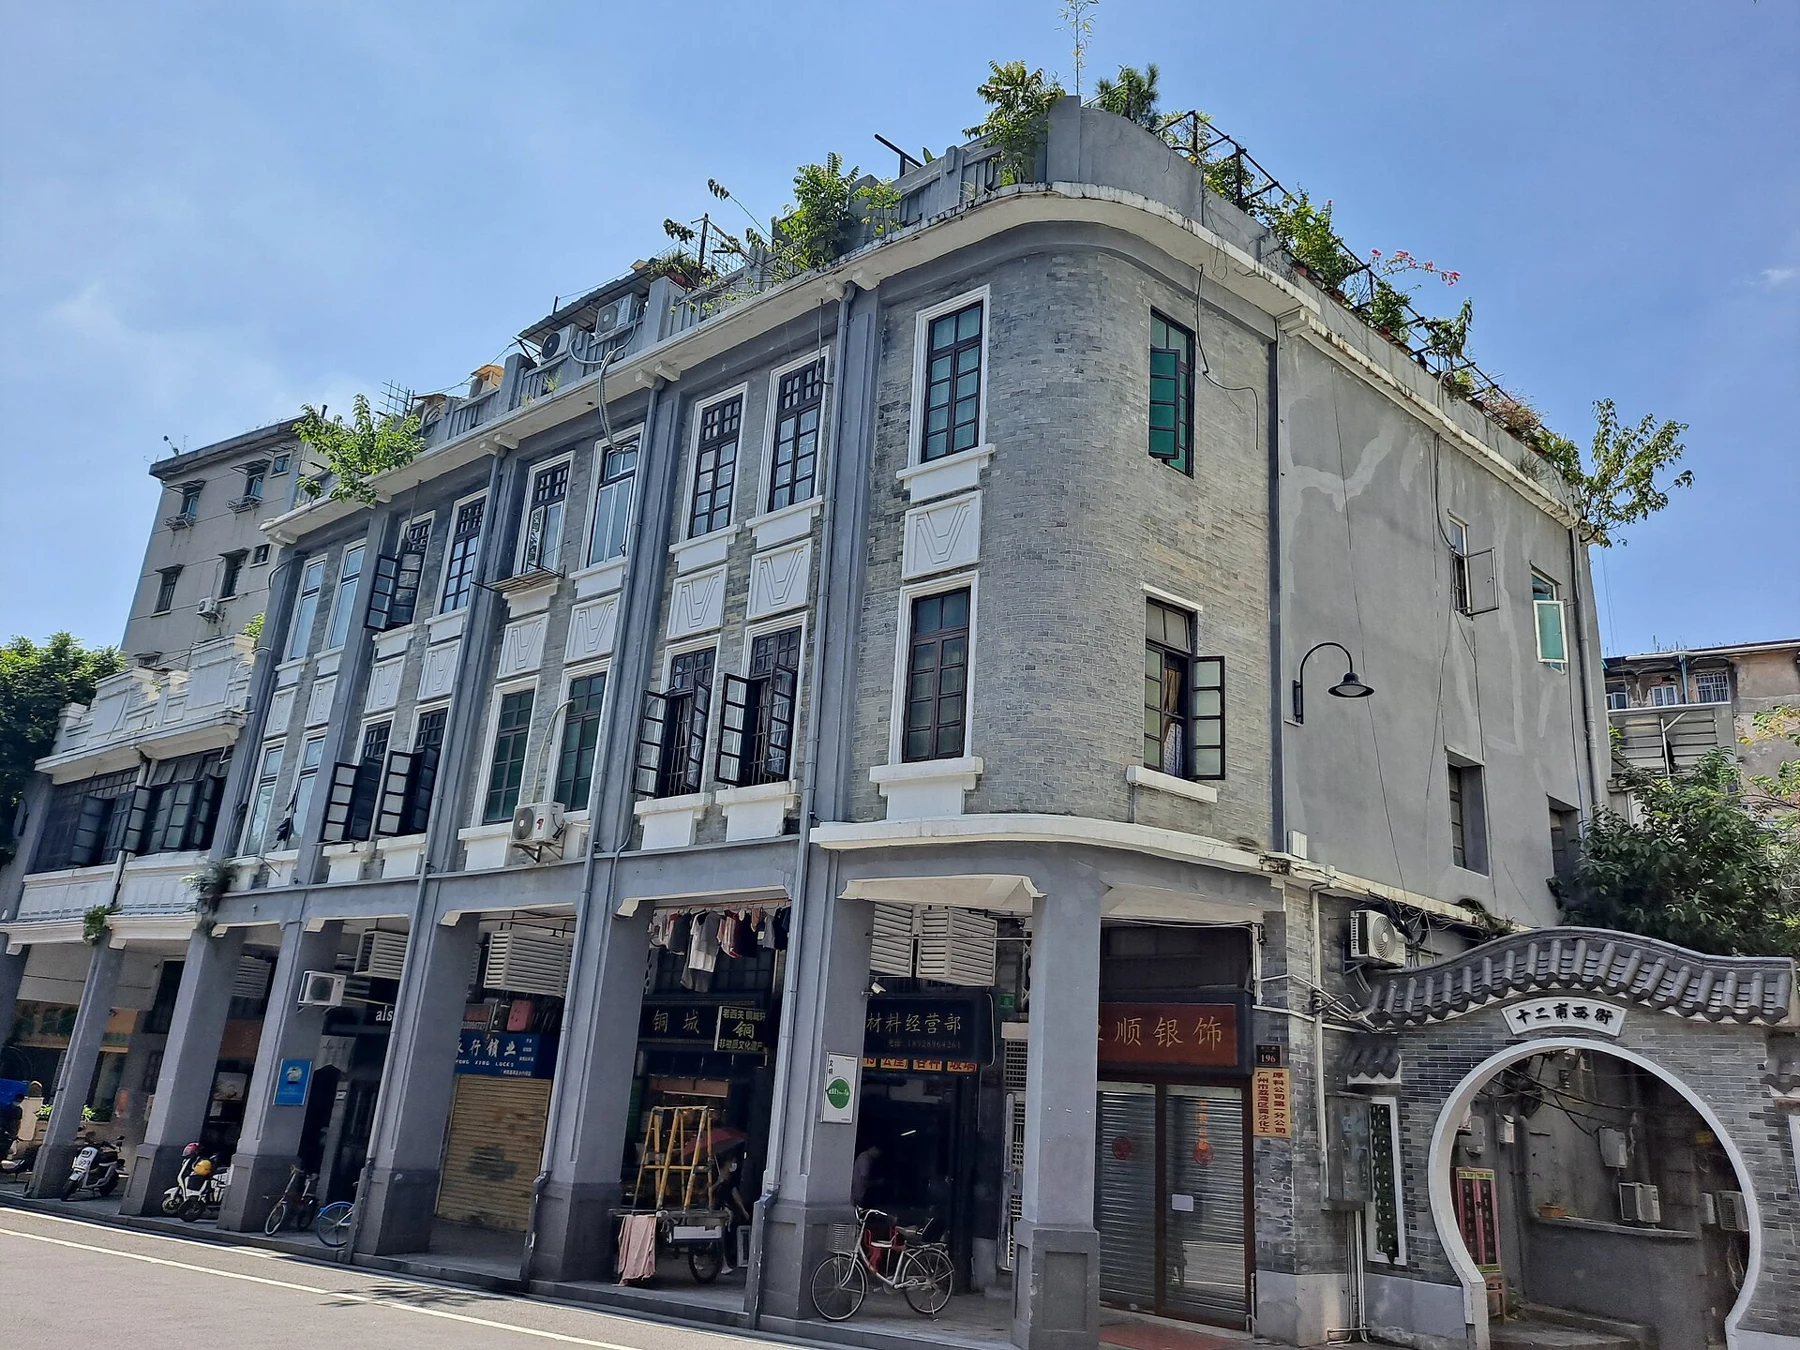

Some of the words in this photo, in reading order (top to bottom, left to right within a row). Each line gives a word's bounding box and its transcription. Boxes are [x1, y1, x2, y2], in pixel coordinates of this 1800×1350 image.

[652, 1009, 700, 1034] 铜城
[866, 1012, 961, 1035] 材料经营部
[1516, 1002, 1613, 1025] 十二甫西街
[732, 1020, 755, 1039] 铜
[1098, 1016, 1223, 1051] 顺银饰
[1261, 1054, 1276, 1063] 196
